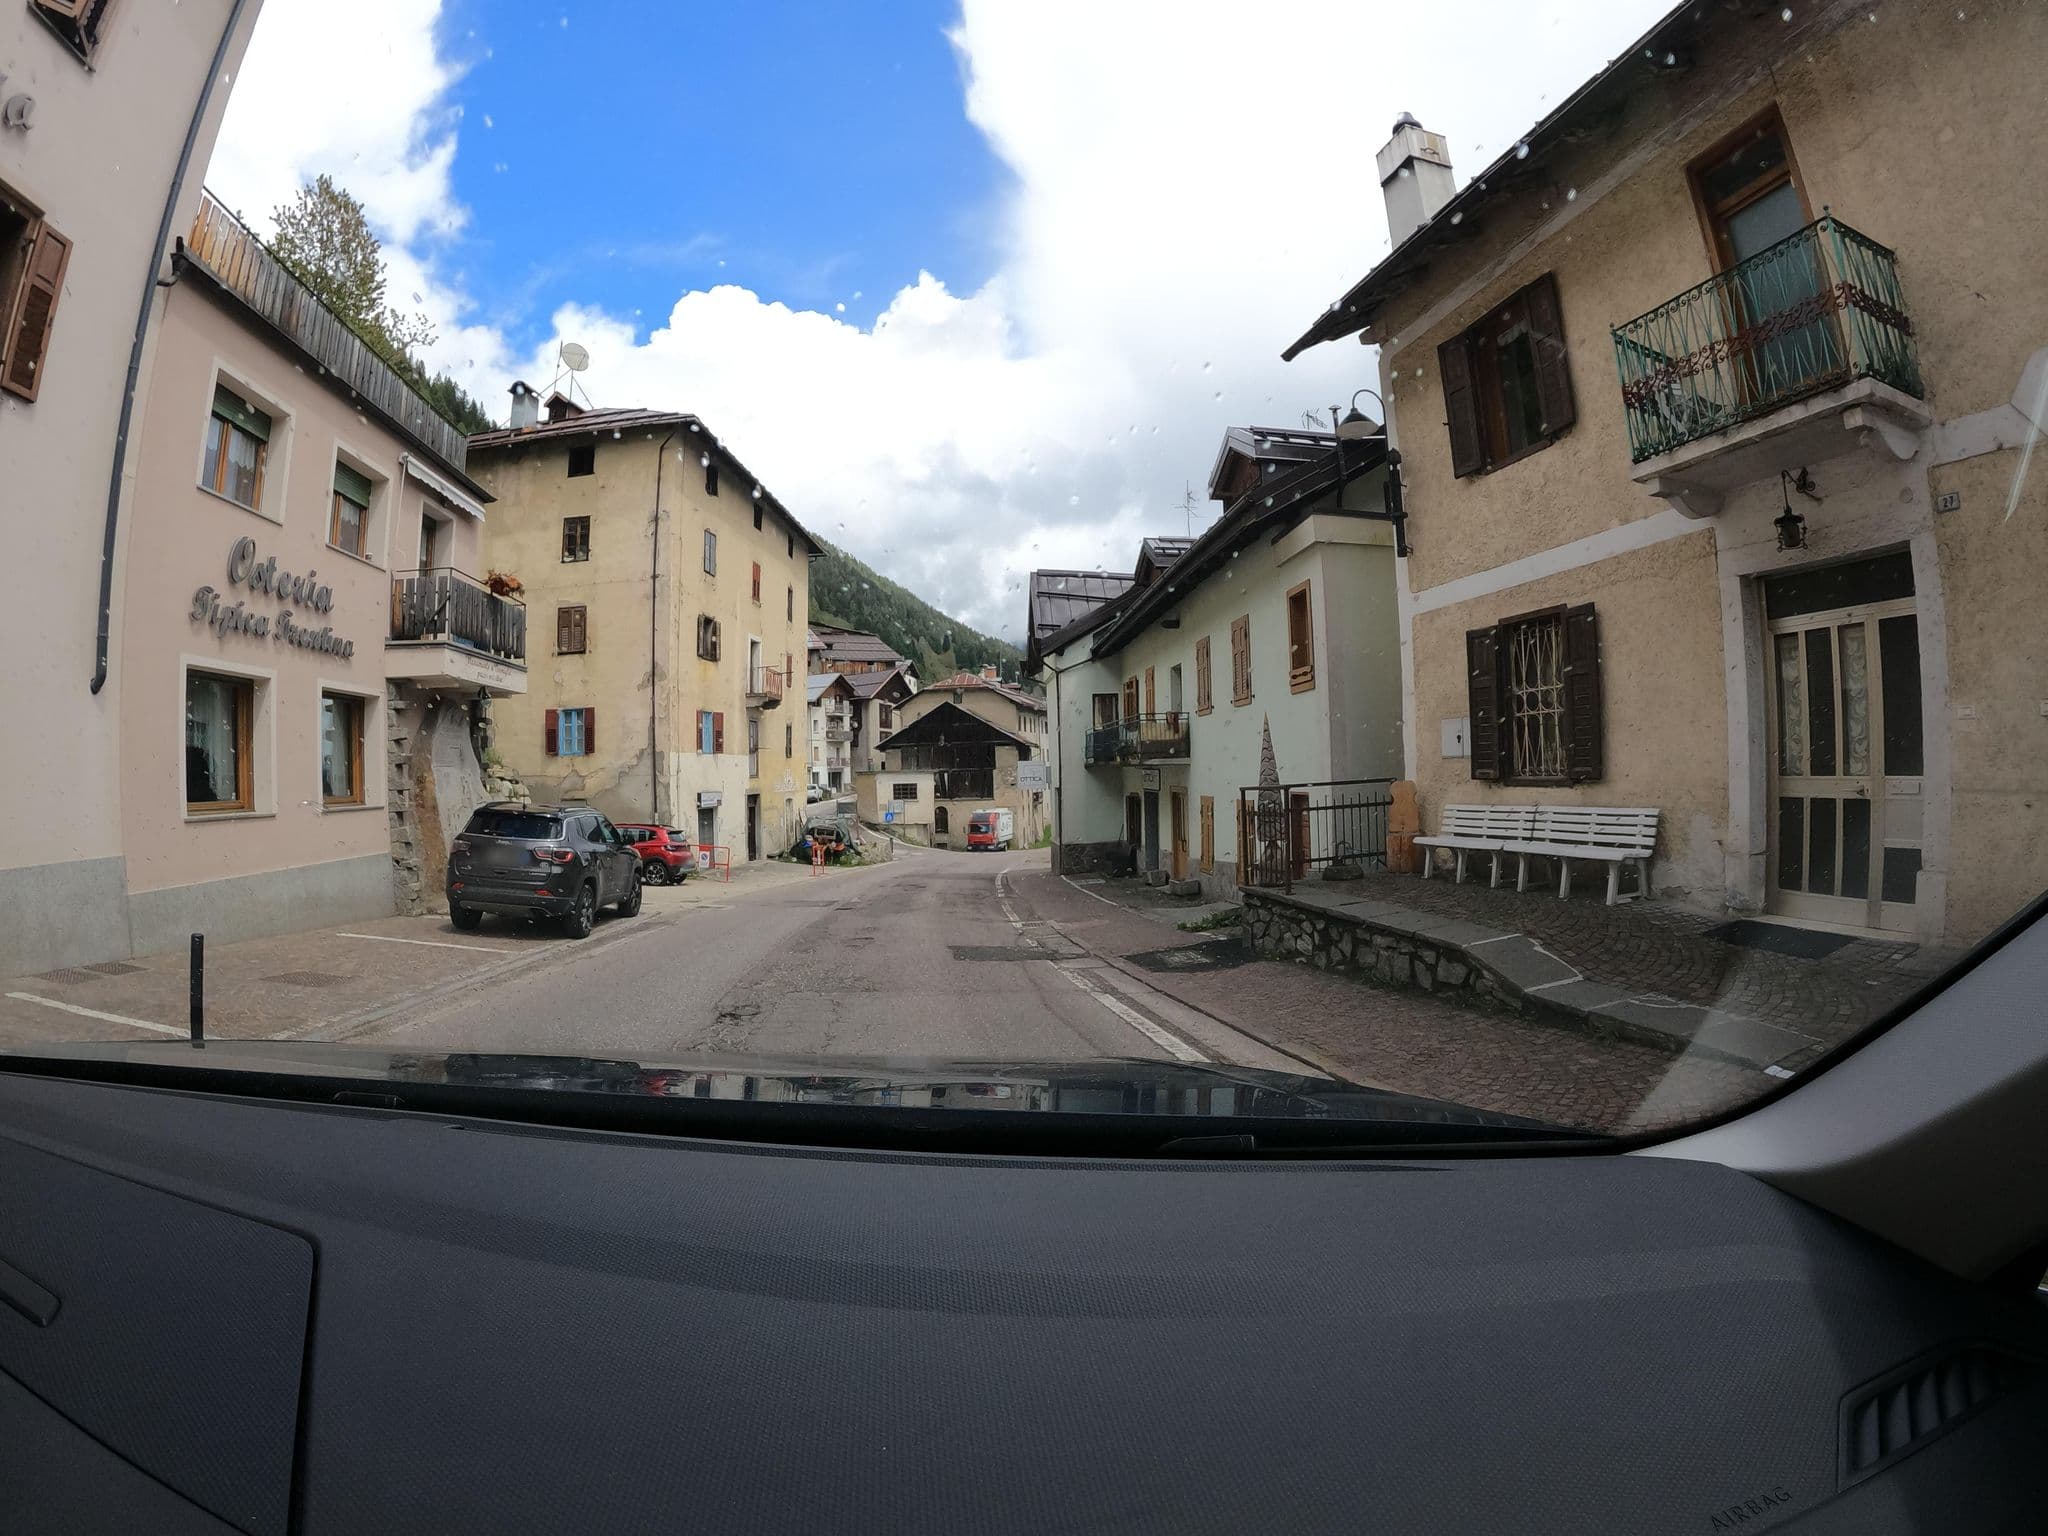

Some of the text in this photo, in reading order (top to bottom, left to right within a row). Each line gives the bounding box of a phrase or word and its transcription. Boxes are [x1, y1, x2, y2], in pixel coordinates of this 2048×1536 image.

[1942, 495, 1954, 508] 27
[228, 536, 335, 615] Osteria
[189, 585, 355, 660] Tipica Trentina
[1711, 1486, 1793, 1533] AIRBAG
